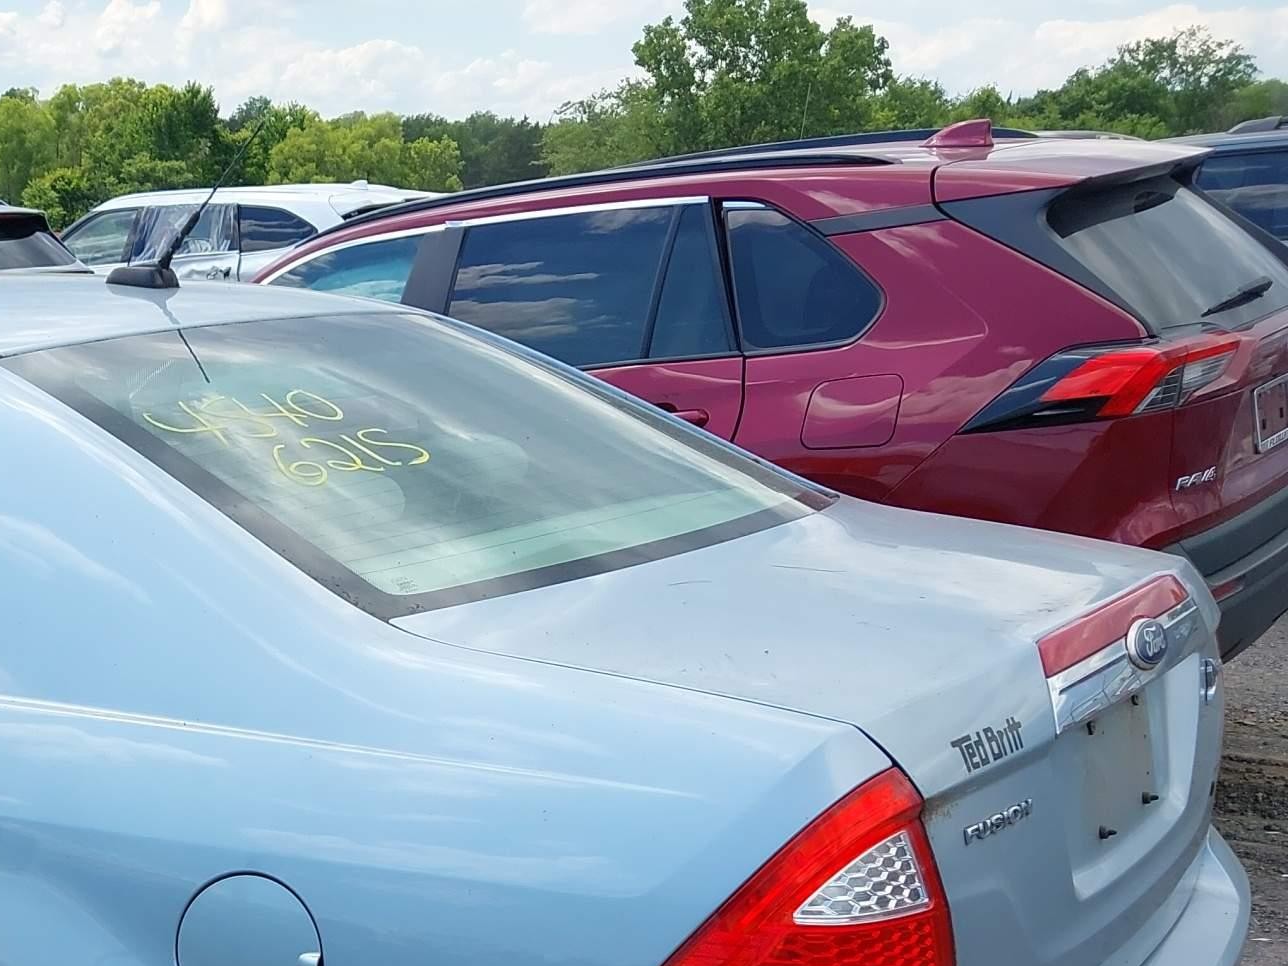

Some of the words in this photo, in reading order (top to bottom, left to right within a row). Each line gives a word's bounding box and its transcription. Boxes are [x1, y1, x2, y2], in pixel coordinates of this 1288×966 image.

[143, 389, 345, 446] 4540
[273, 428, 430, 487] 6215
[1142, 625, 1167, 657] Ford
[950, 727, 990, 773] Ted
[985, 716, 1024, 763] Britt
[963, 798, 1033, 845] FUSION
